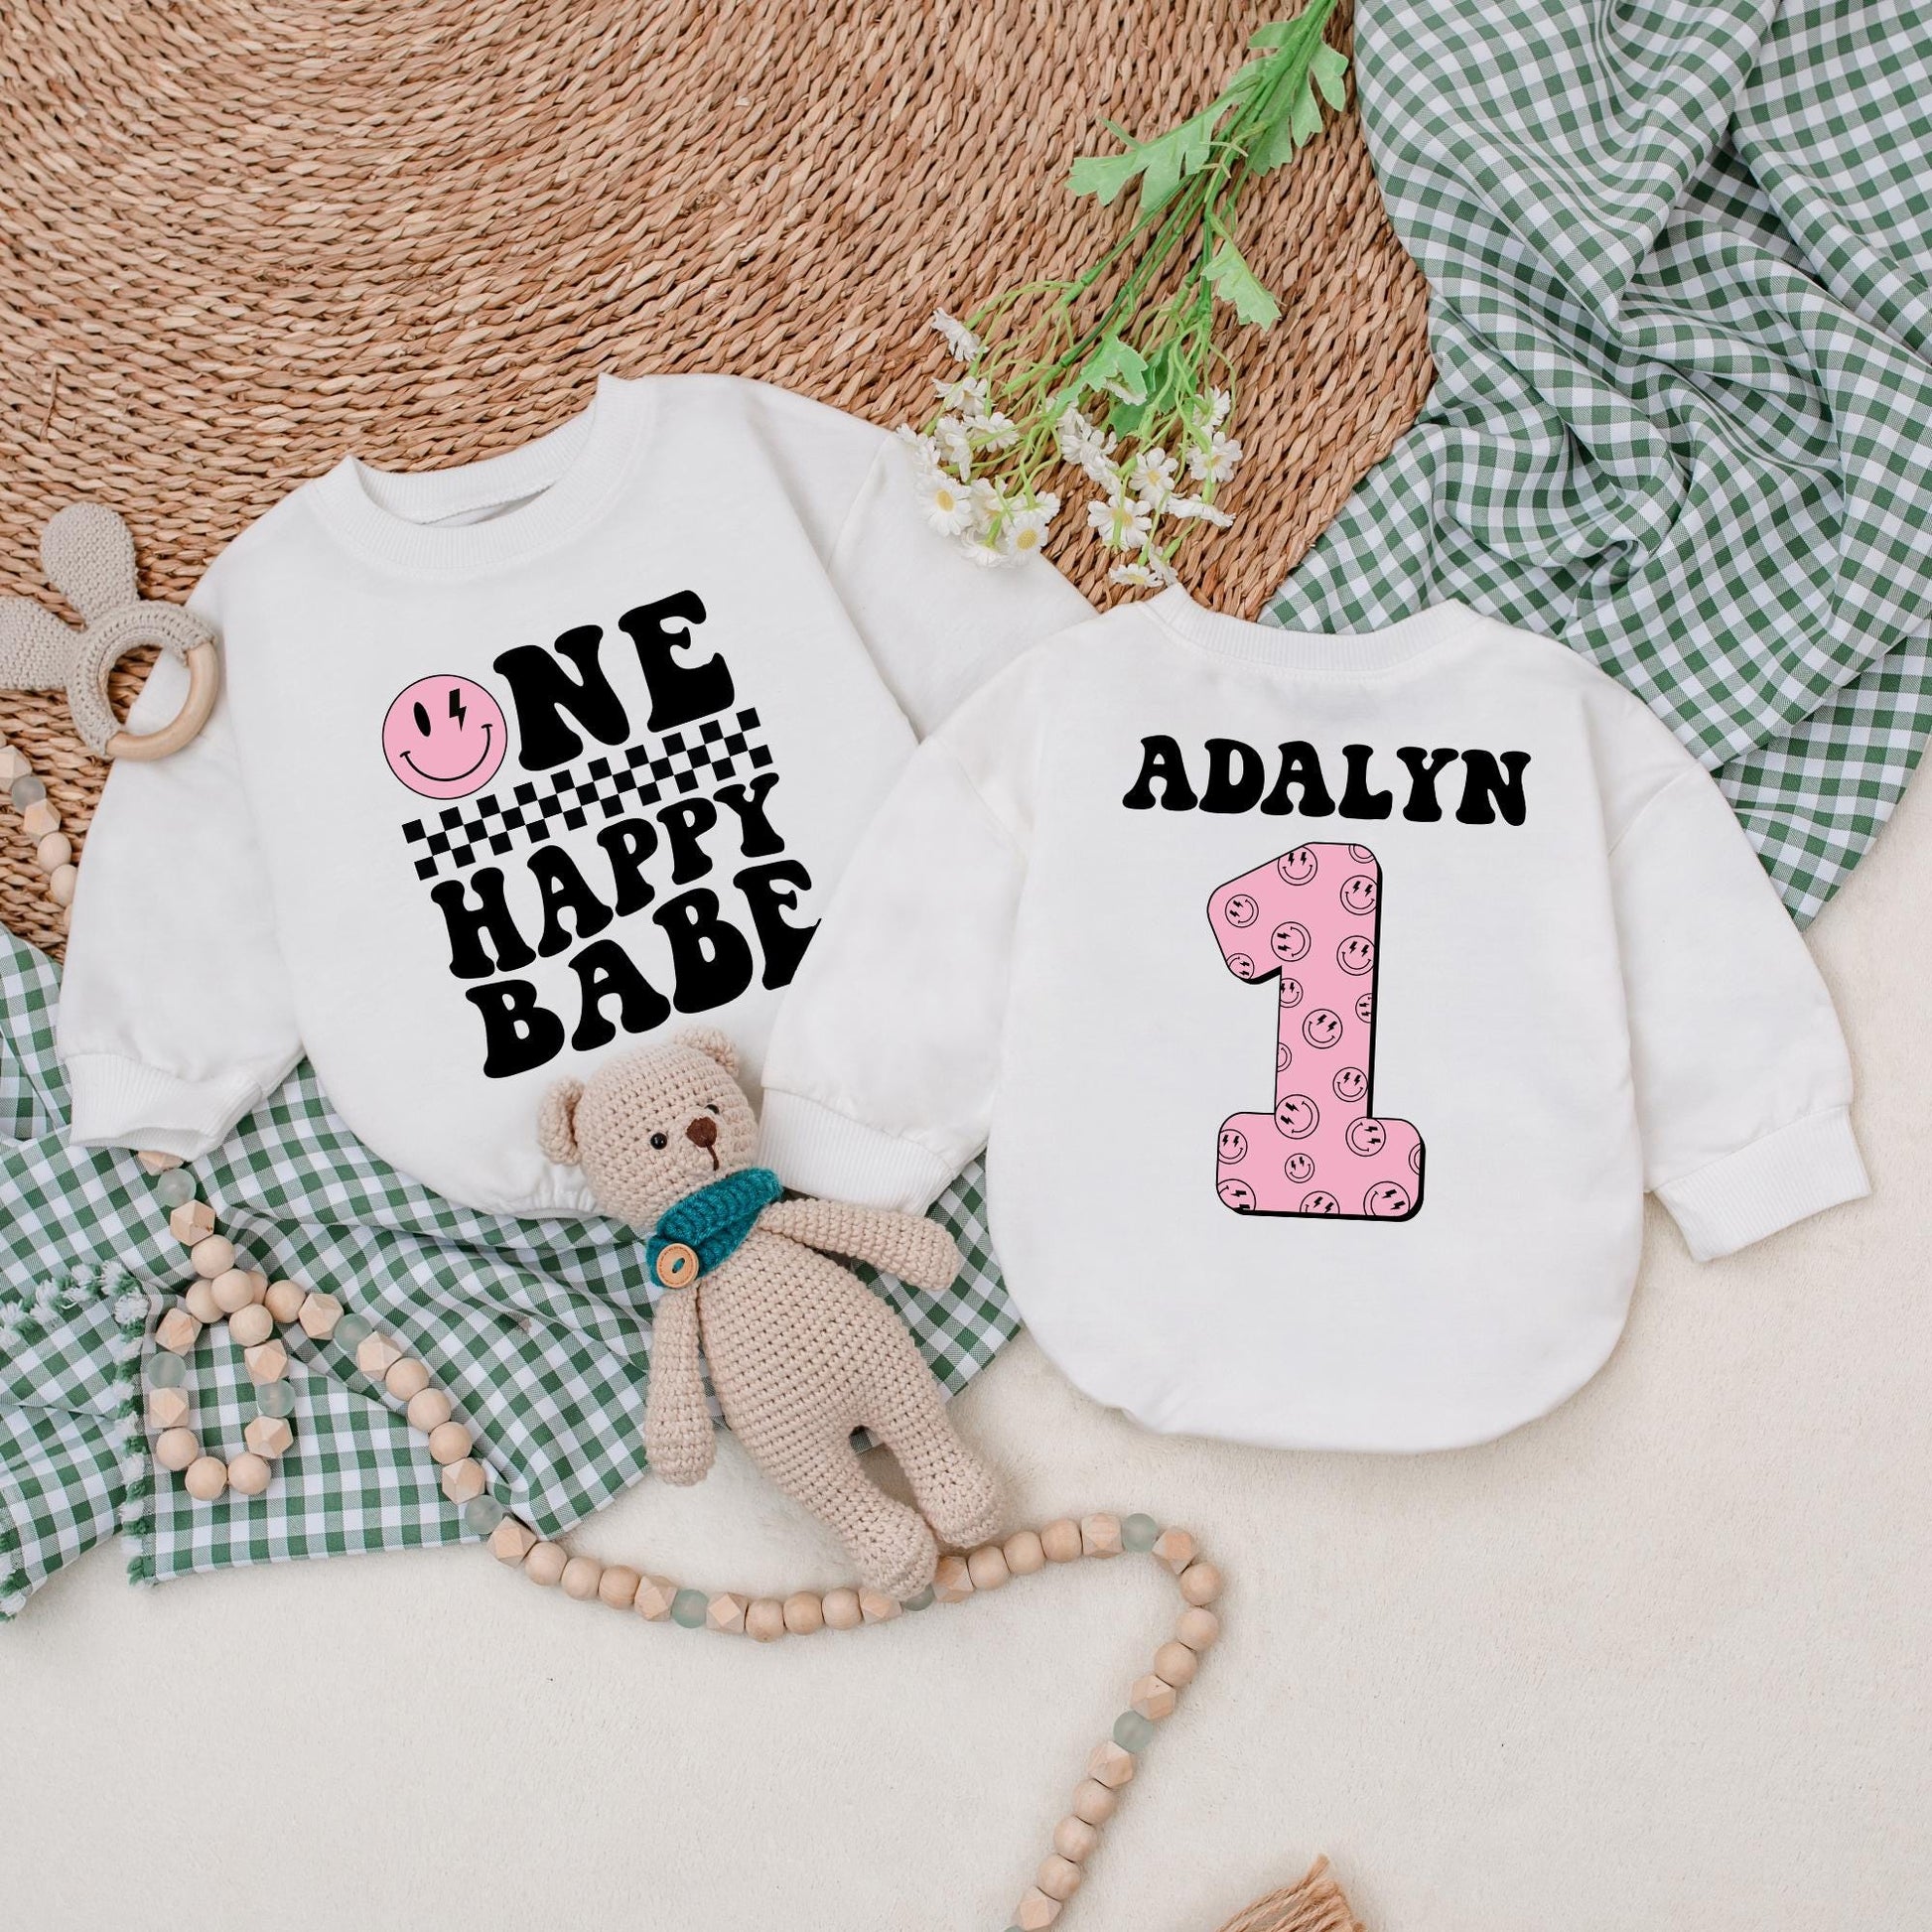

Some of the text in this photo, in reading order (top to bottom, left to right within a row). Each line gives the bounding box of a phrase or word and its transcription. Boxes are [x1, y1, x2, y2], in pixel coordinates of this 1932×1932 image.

[430, 771, 785, 980] HAPPY
[1122, 735, 1532, 827] ADALYN
[465, 859, 822, 1079] BABE
[1206, 841, 1427, 1223] 1
